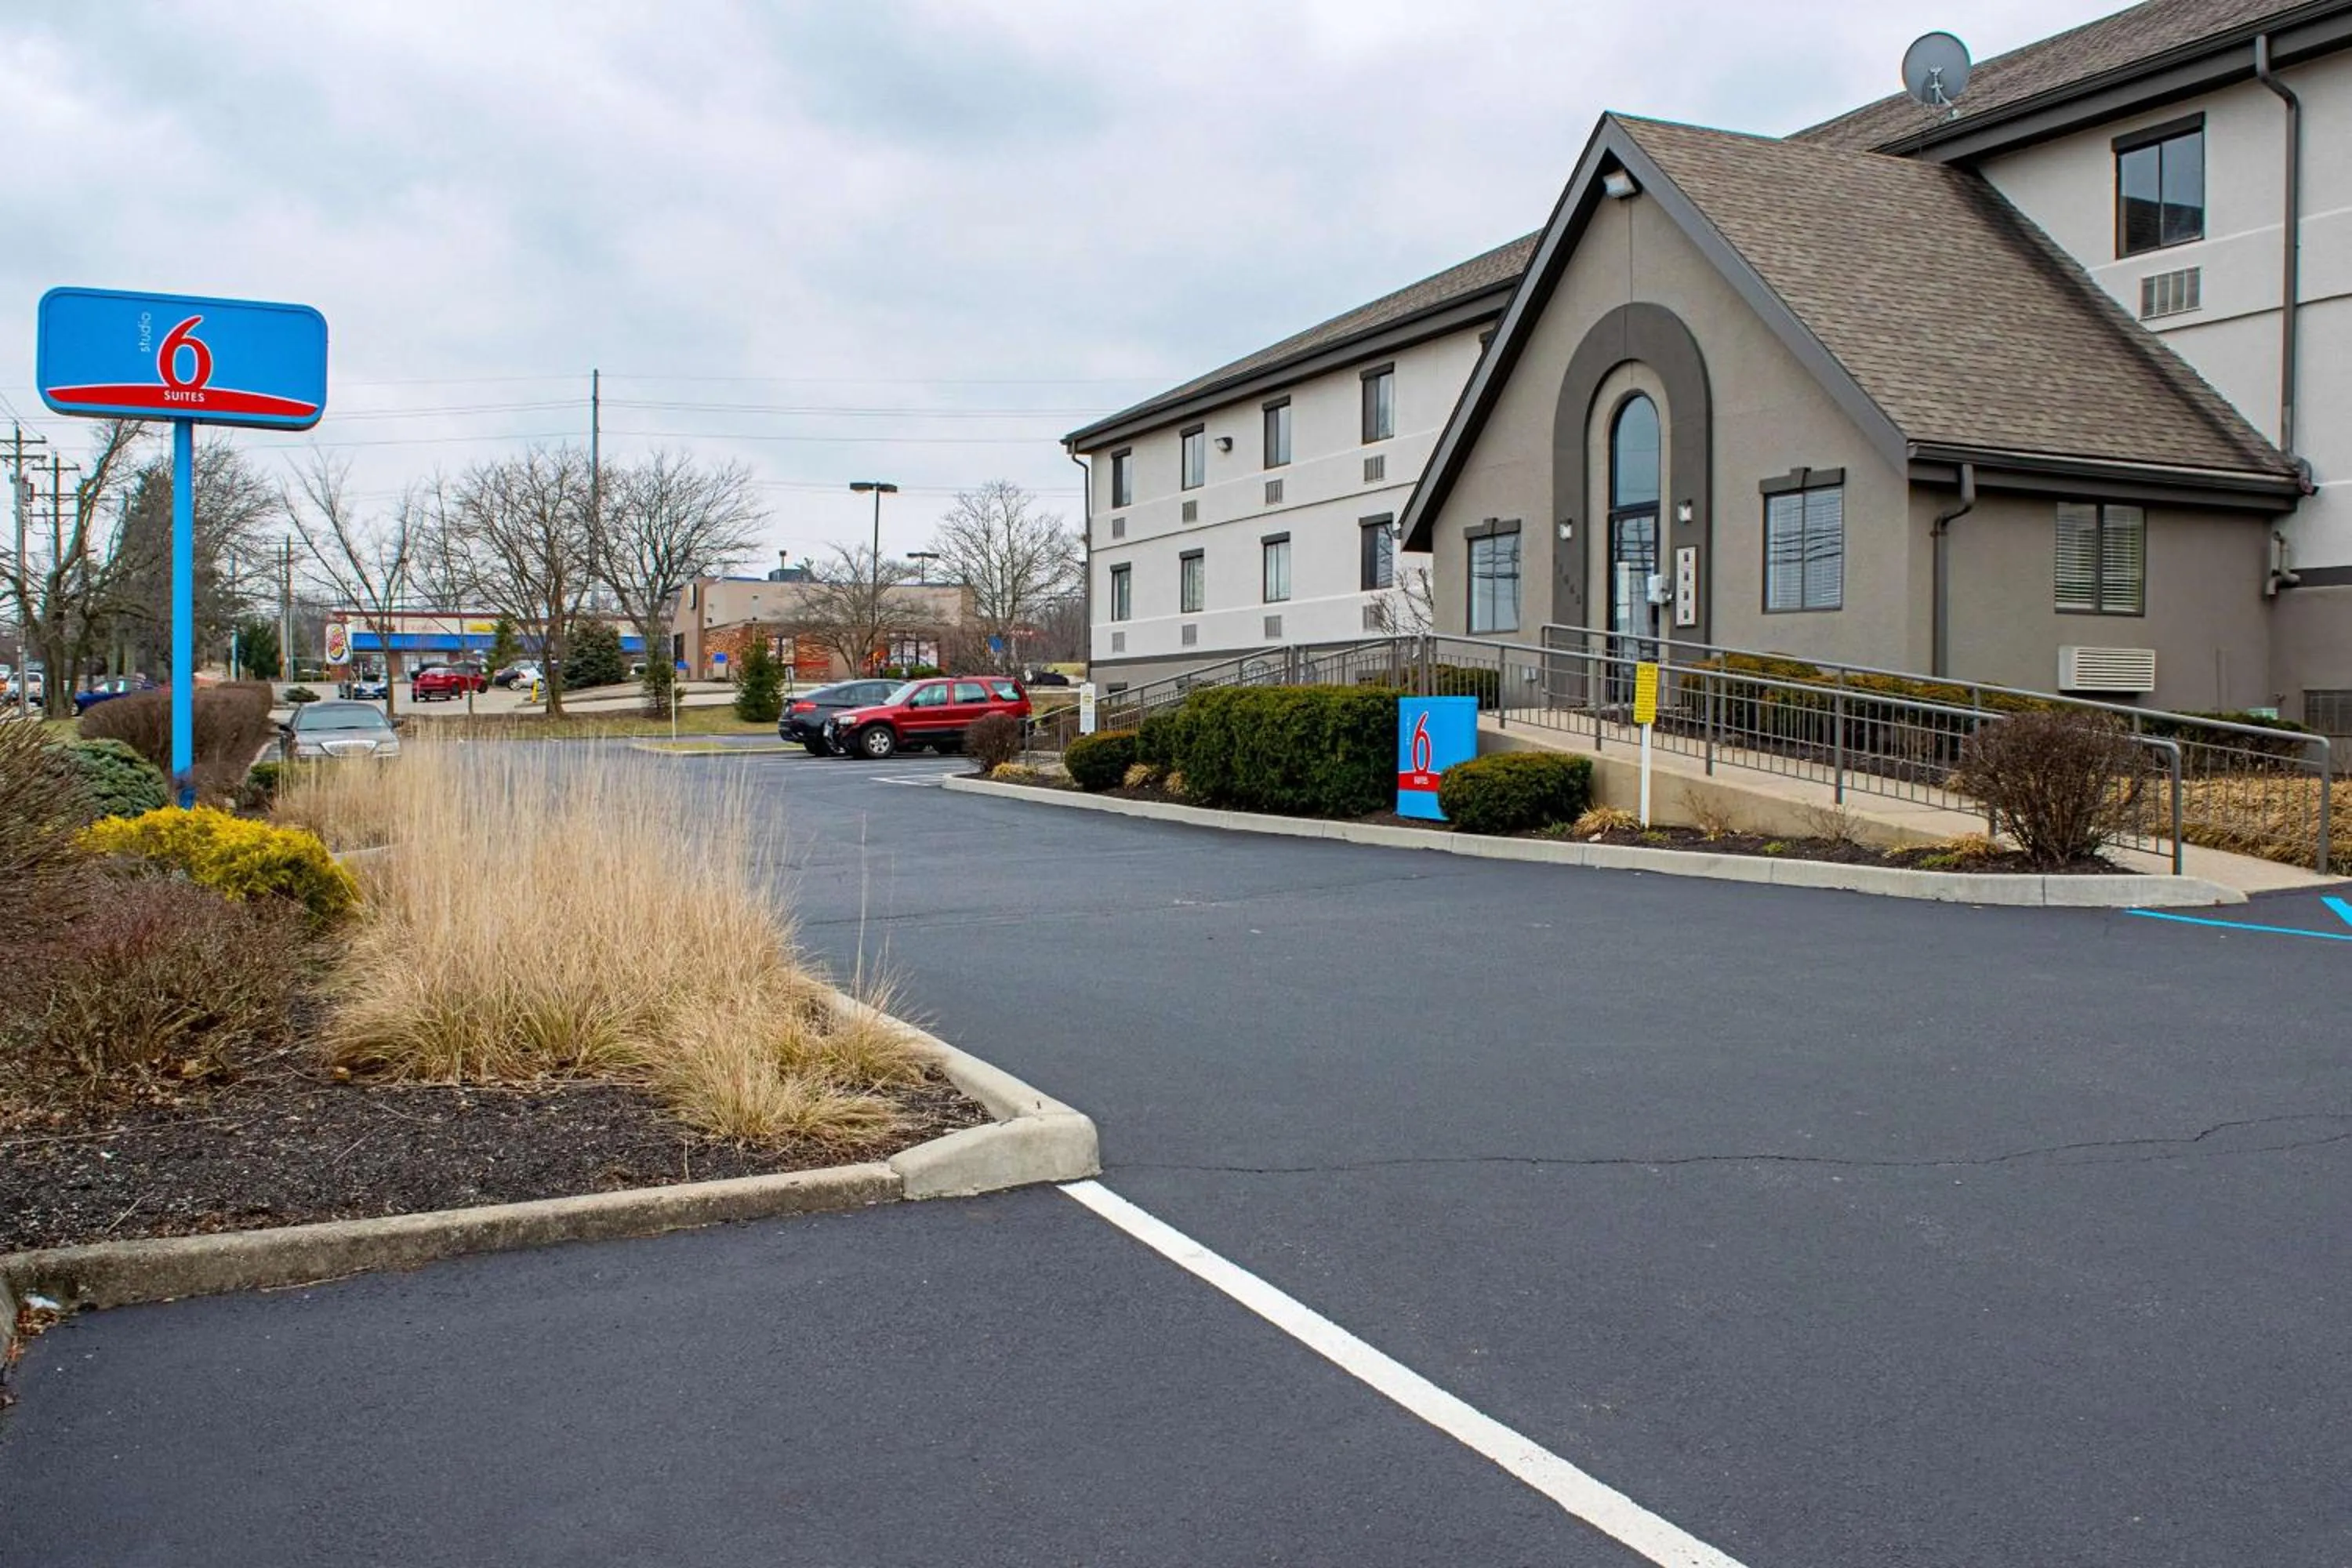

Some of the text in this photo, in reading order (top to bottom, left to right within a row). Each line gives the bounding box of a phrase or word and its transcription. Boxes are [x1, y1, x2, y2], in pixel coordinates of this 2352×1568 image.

[137, 312, 152, 353] studio
[157, 314, 213, 390] 6
[163, 390, 205, 402] SUITES
[1412, 711, 1432, 773] 6
